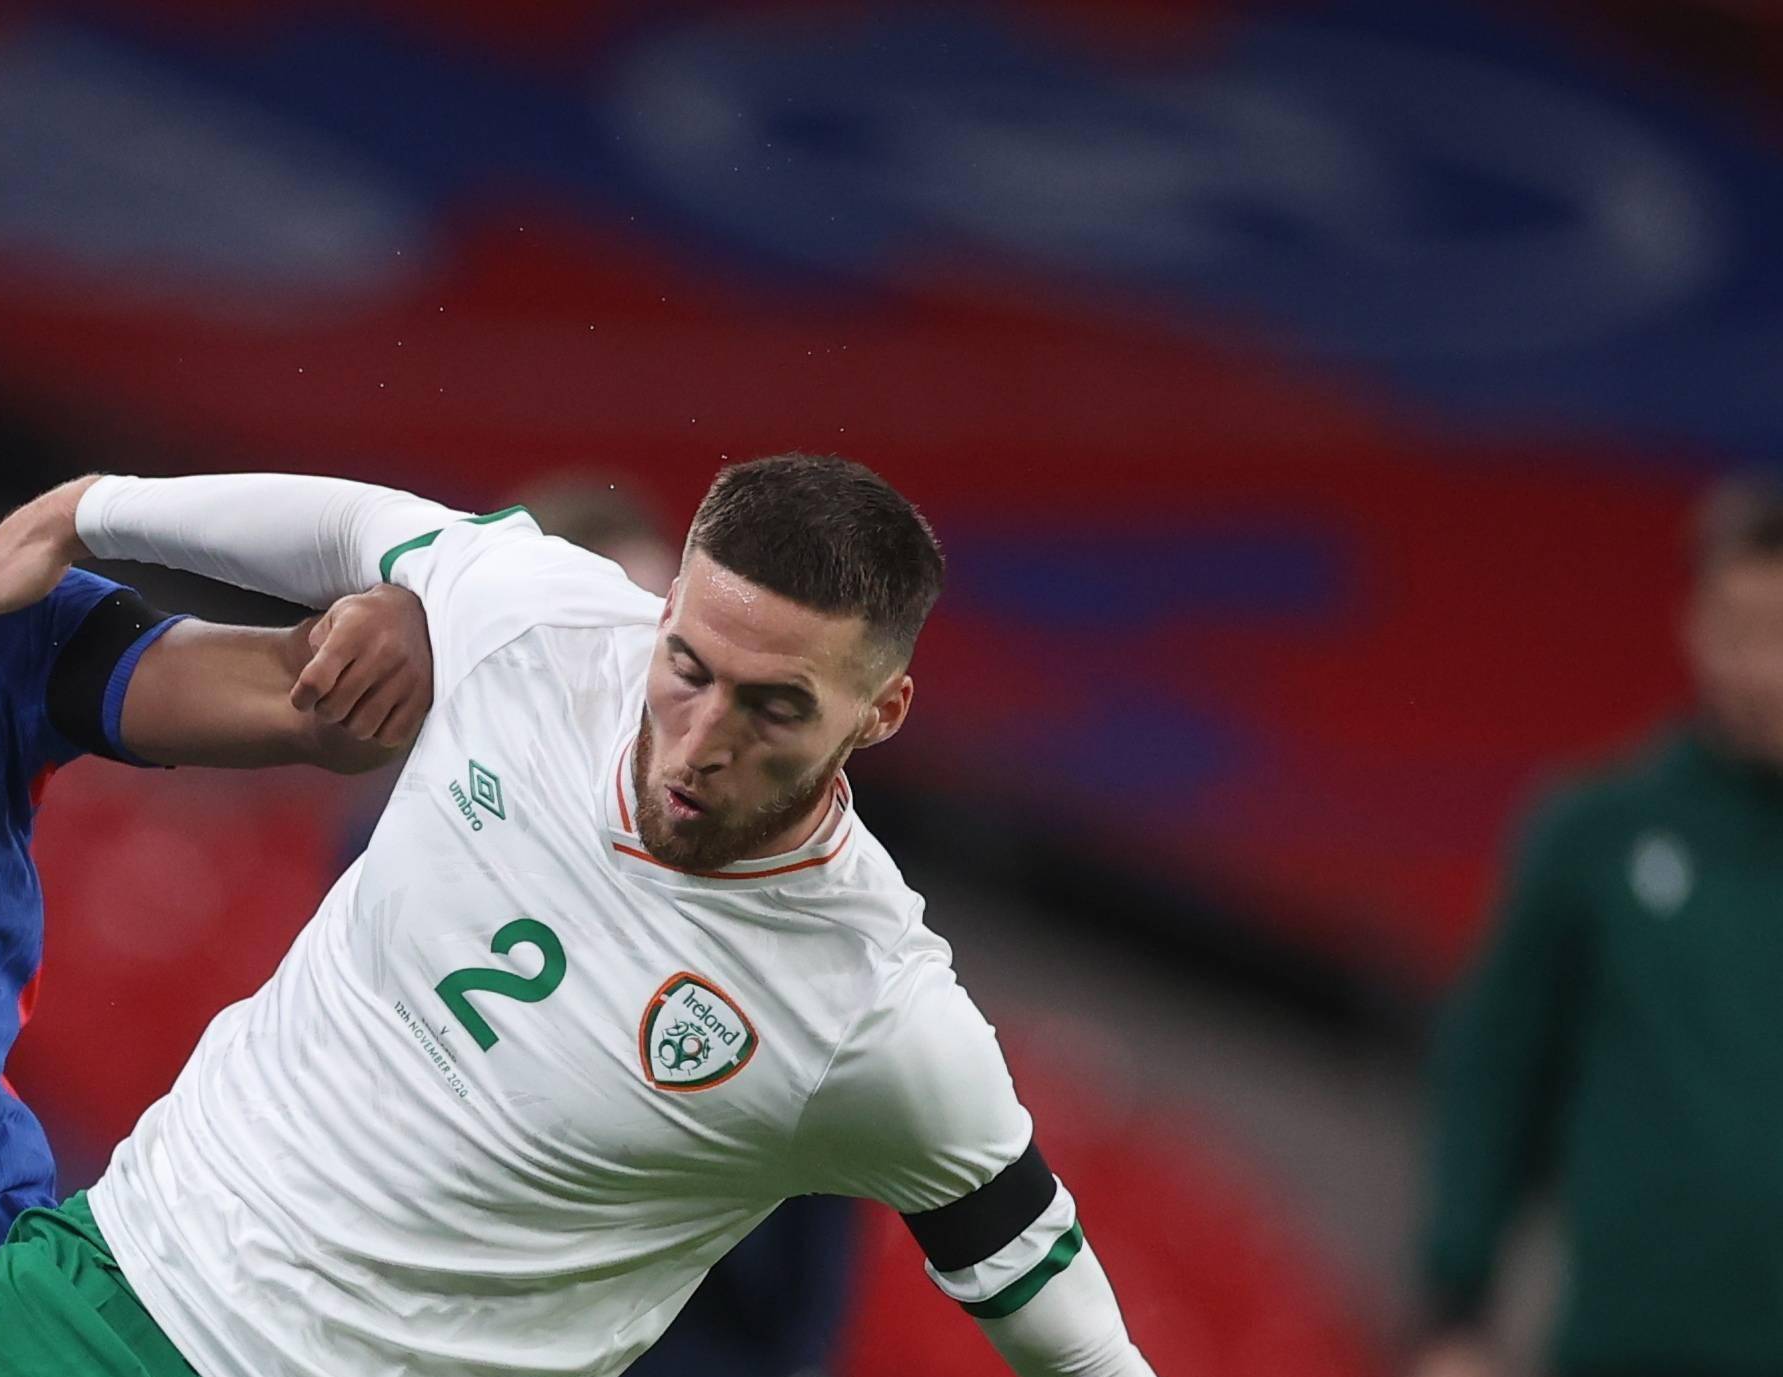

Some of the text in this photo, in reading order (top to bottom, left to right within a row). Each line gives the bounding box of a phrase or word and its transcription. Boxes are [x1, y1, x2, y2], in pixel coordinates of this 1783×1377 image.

[449, 779, 483, 831] umbro
[434, 918, 567, 1052] 2
[683, 987, 740, 1046] Ireland
[394, 1001, 411, 1024] 12th
[408, 1021, 451, 1074] NOVEMBER
[446, 1073, 468, 1098] 2020
